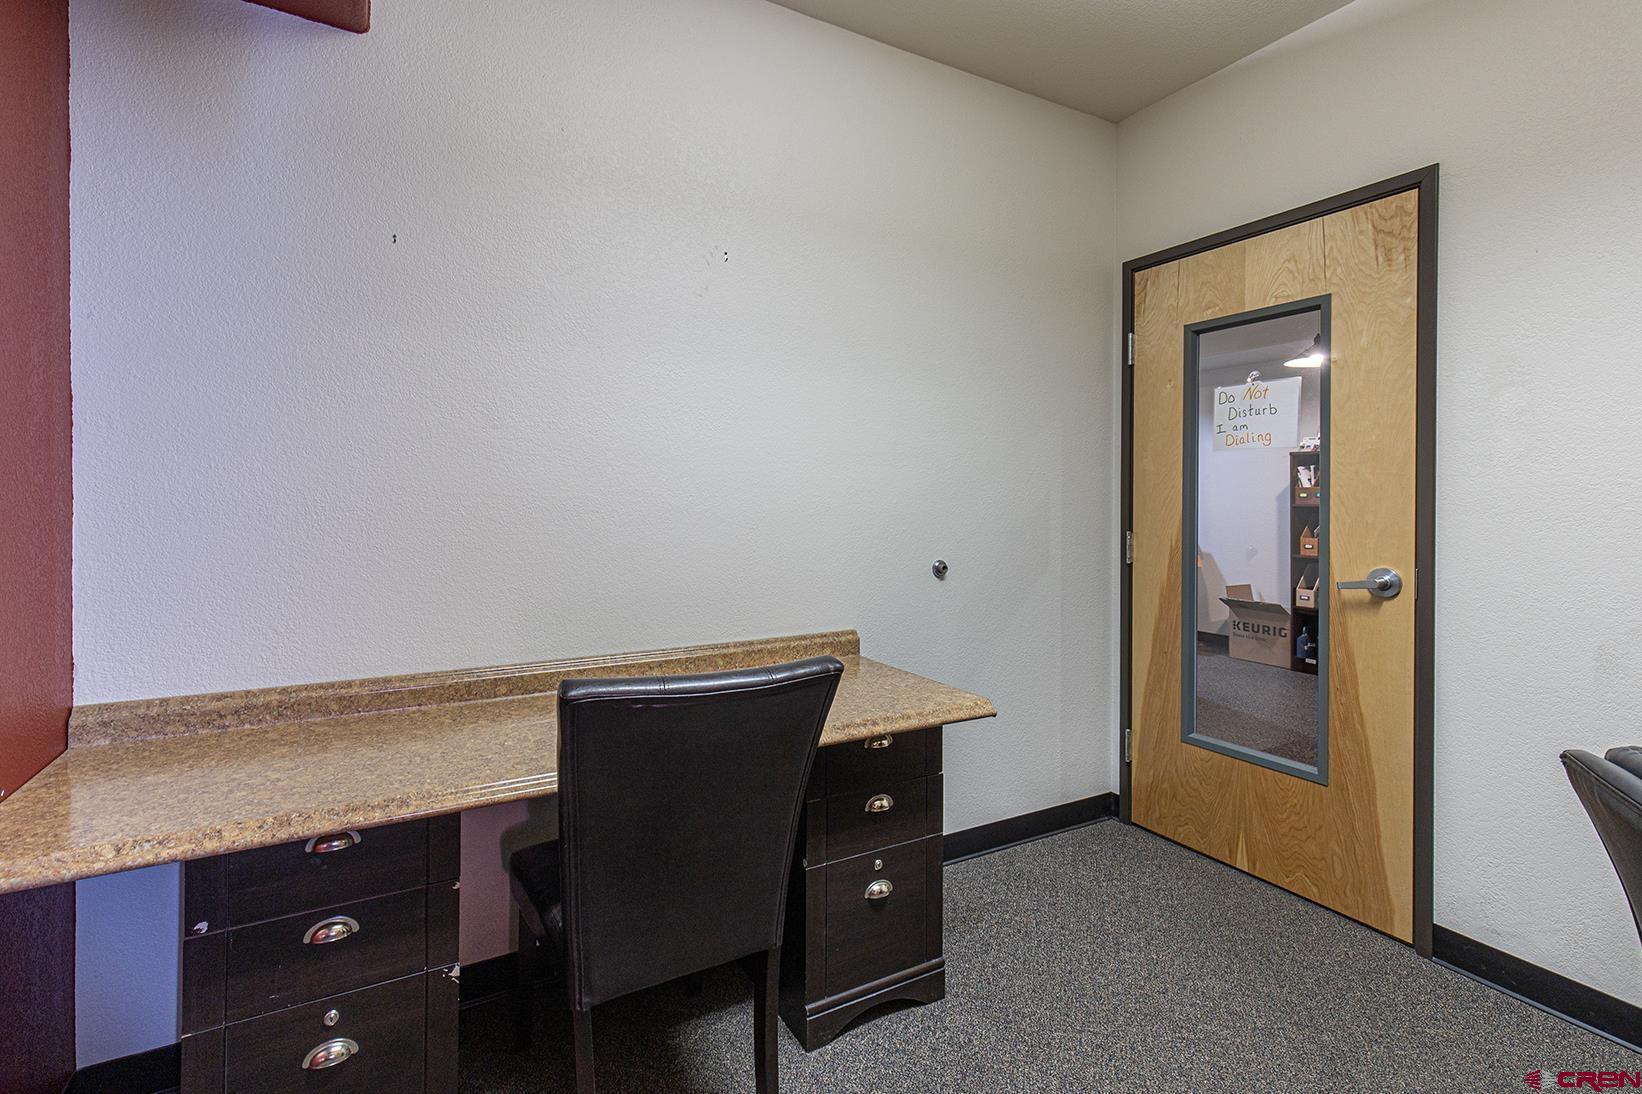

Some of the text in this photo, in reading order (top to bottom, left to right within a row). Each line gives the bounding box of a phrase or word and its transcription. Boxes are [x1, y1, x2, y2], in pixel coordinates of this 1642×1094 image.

[1218, 385, 1269, 405] Do Not
[1228, 403, 1278, 421] Disturb
[1216, 423, 1249, 435] I am
[1225, 432, 1272, 447] Dialing
[1232, 620, 1288, 638] KEURIG
